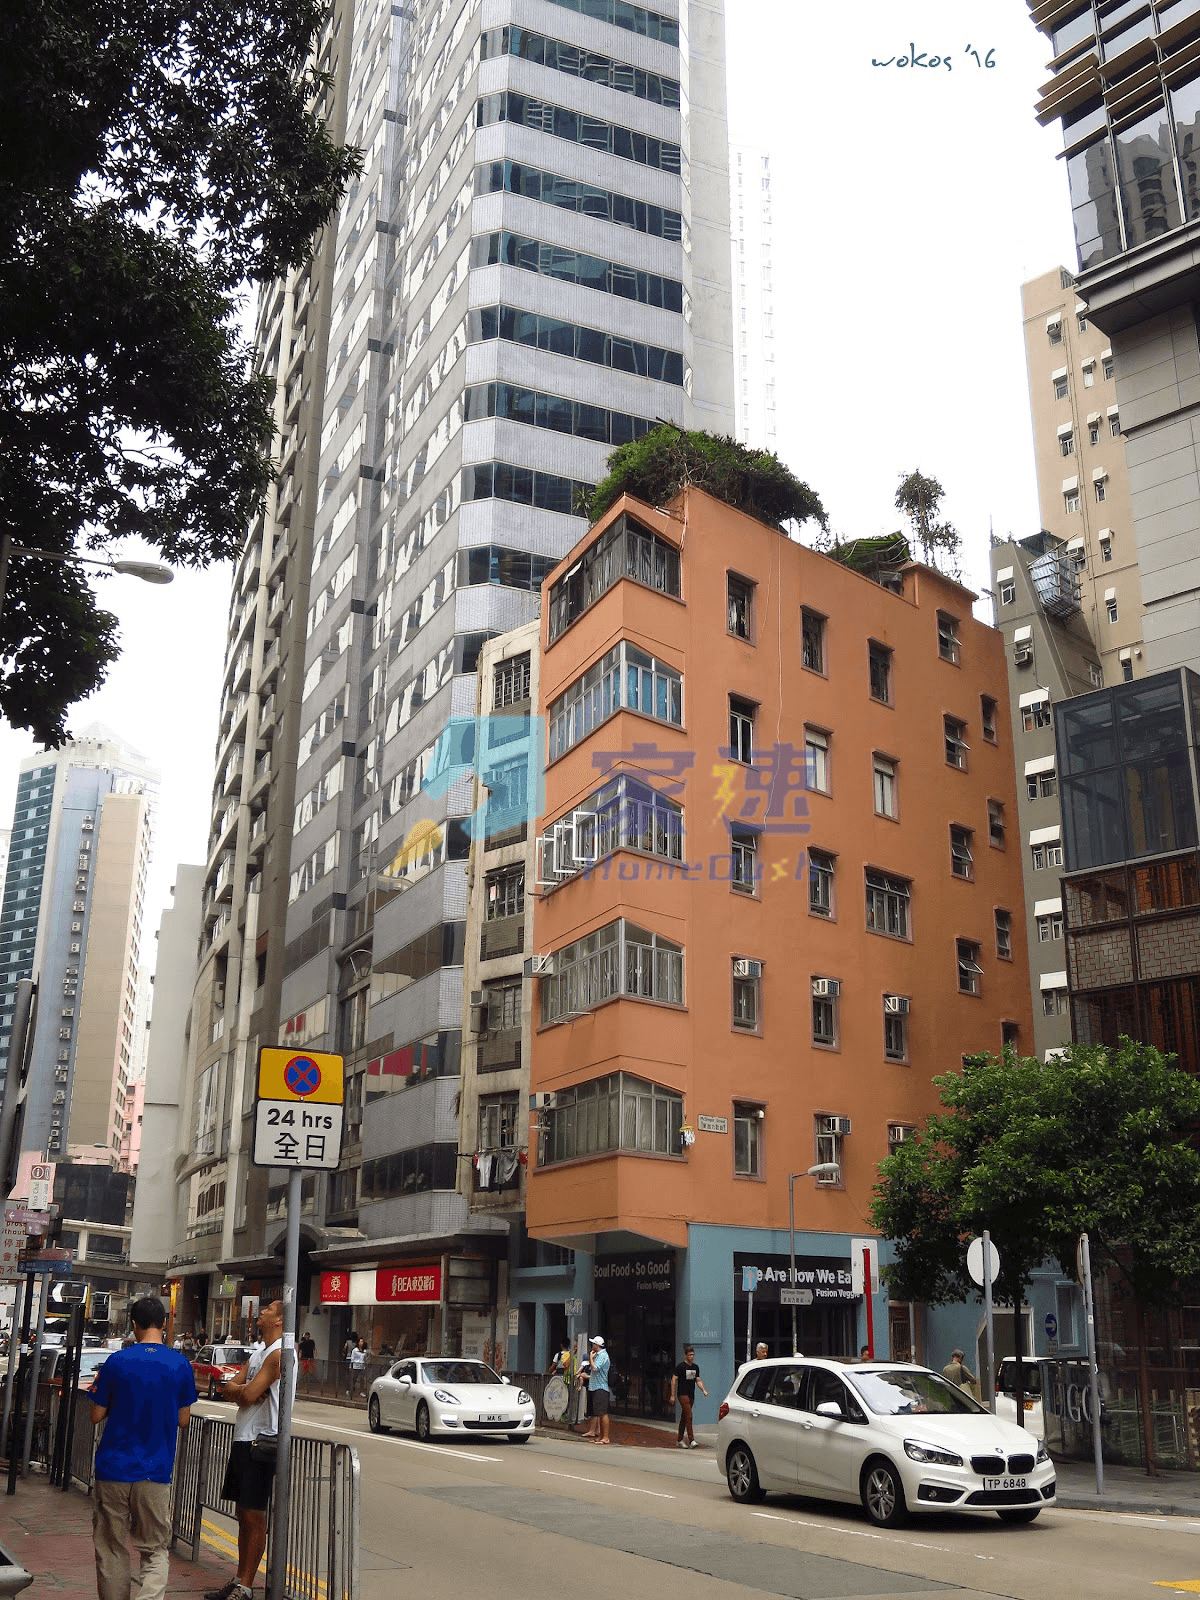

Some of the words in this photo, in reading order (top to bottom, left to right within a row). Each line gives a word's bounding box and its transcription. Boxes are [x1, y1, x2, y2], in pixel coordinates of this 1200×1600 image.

[267, 1108, 295, 1126] 24
[302, 1111, 332, 1130] hrs
[274, 1132, 326, 1161] 全日
[594, 1263, 610, 1278] Soul
[611, 1262, 630, 1277] Food
[635, 1262, 646, 1276] So
[647, 1260, 670, 1275] Good
[764, 1266, 787, 1282] Are
[816, 1269, 836, 1284] We
[836, 1270, 853, 1285] Ea
[815, 1288, 838, 1298] Fusion
[987, 1479, 1001, 1489] TP
[1003, 1478, 1026, 1489] 6848
